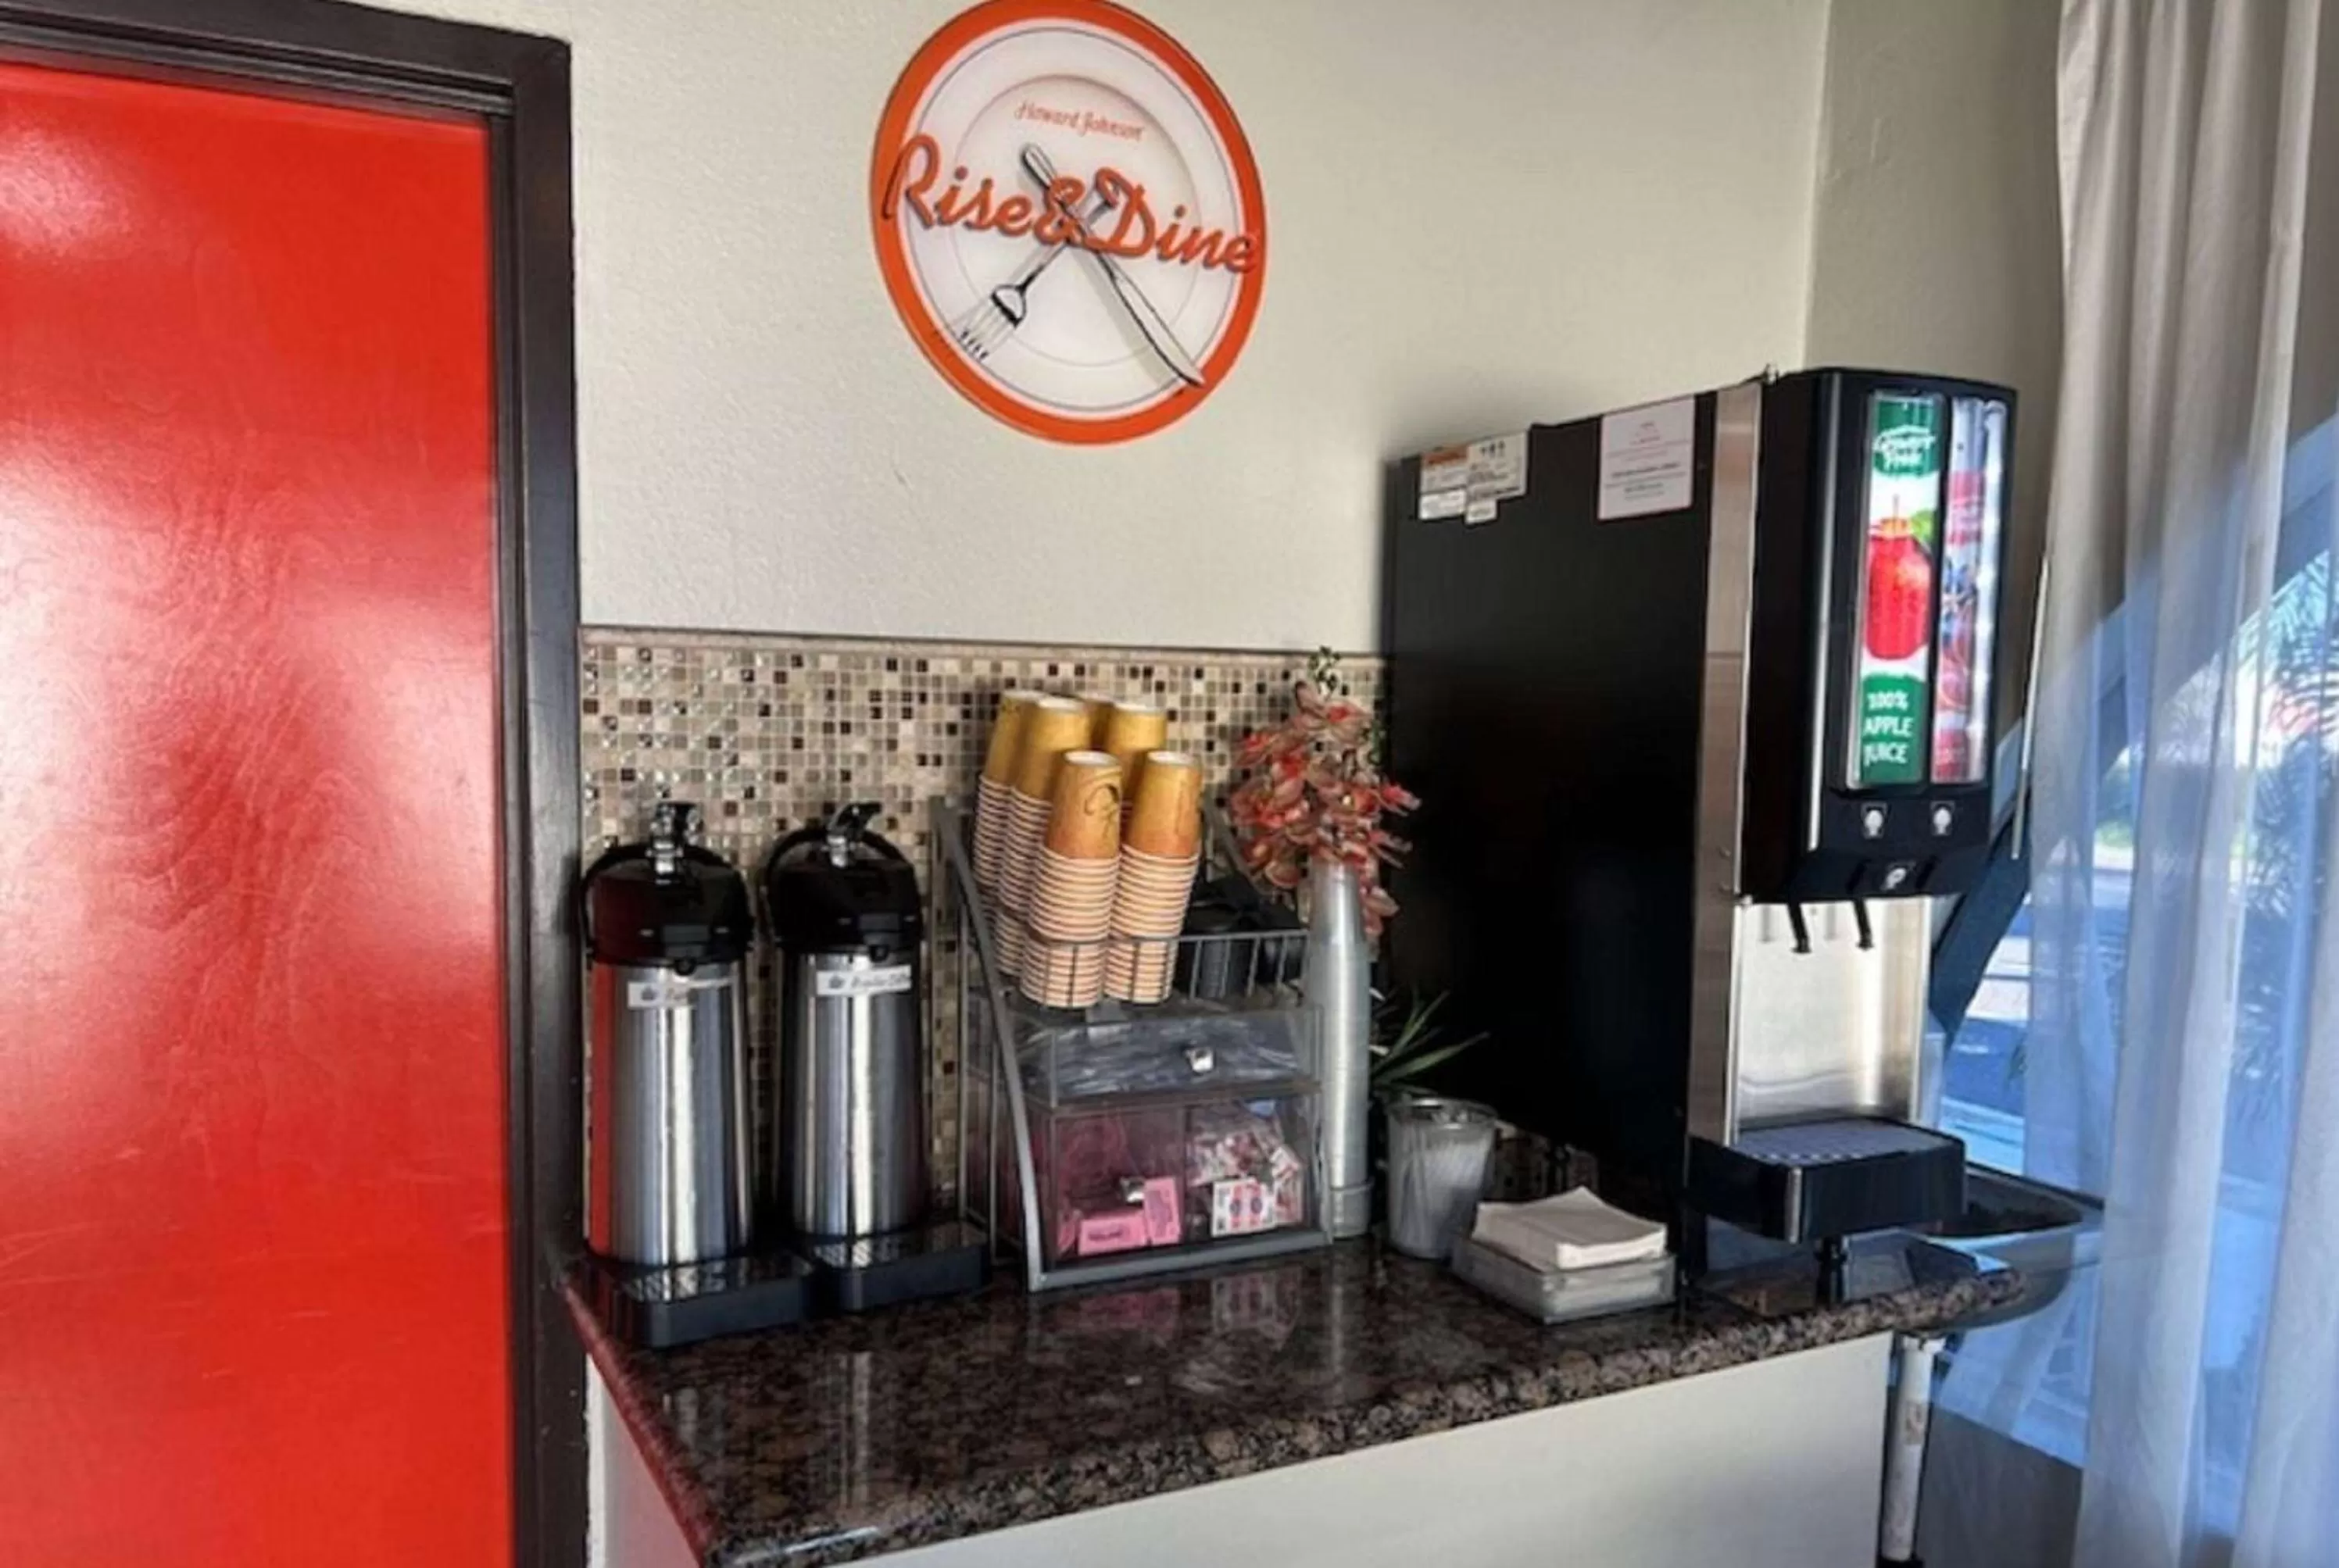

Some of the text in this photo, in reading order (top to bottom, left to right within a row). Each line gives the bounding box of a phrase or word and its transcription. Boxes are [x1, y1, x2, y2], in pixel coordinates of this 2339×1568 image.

[1014, 100, 1080, 129] Howard
[1866, 690, 1909, 711] 100%
[1862, 716, 1914, 738] APPLE
[1863, 741, 1908, 767] JUICE
